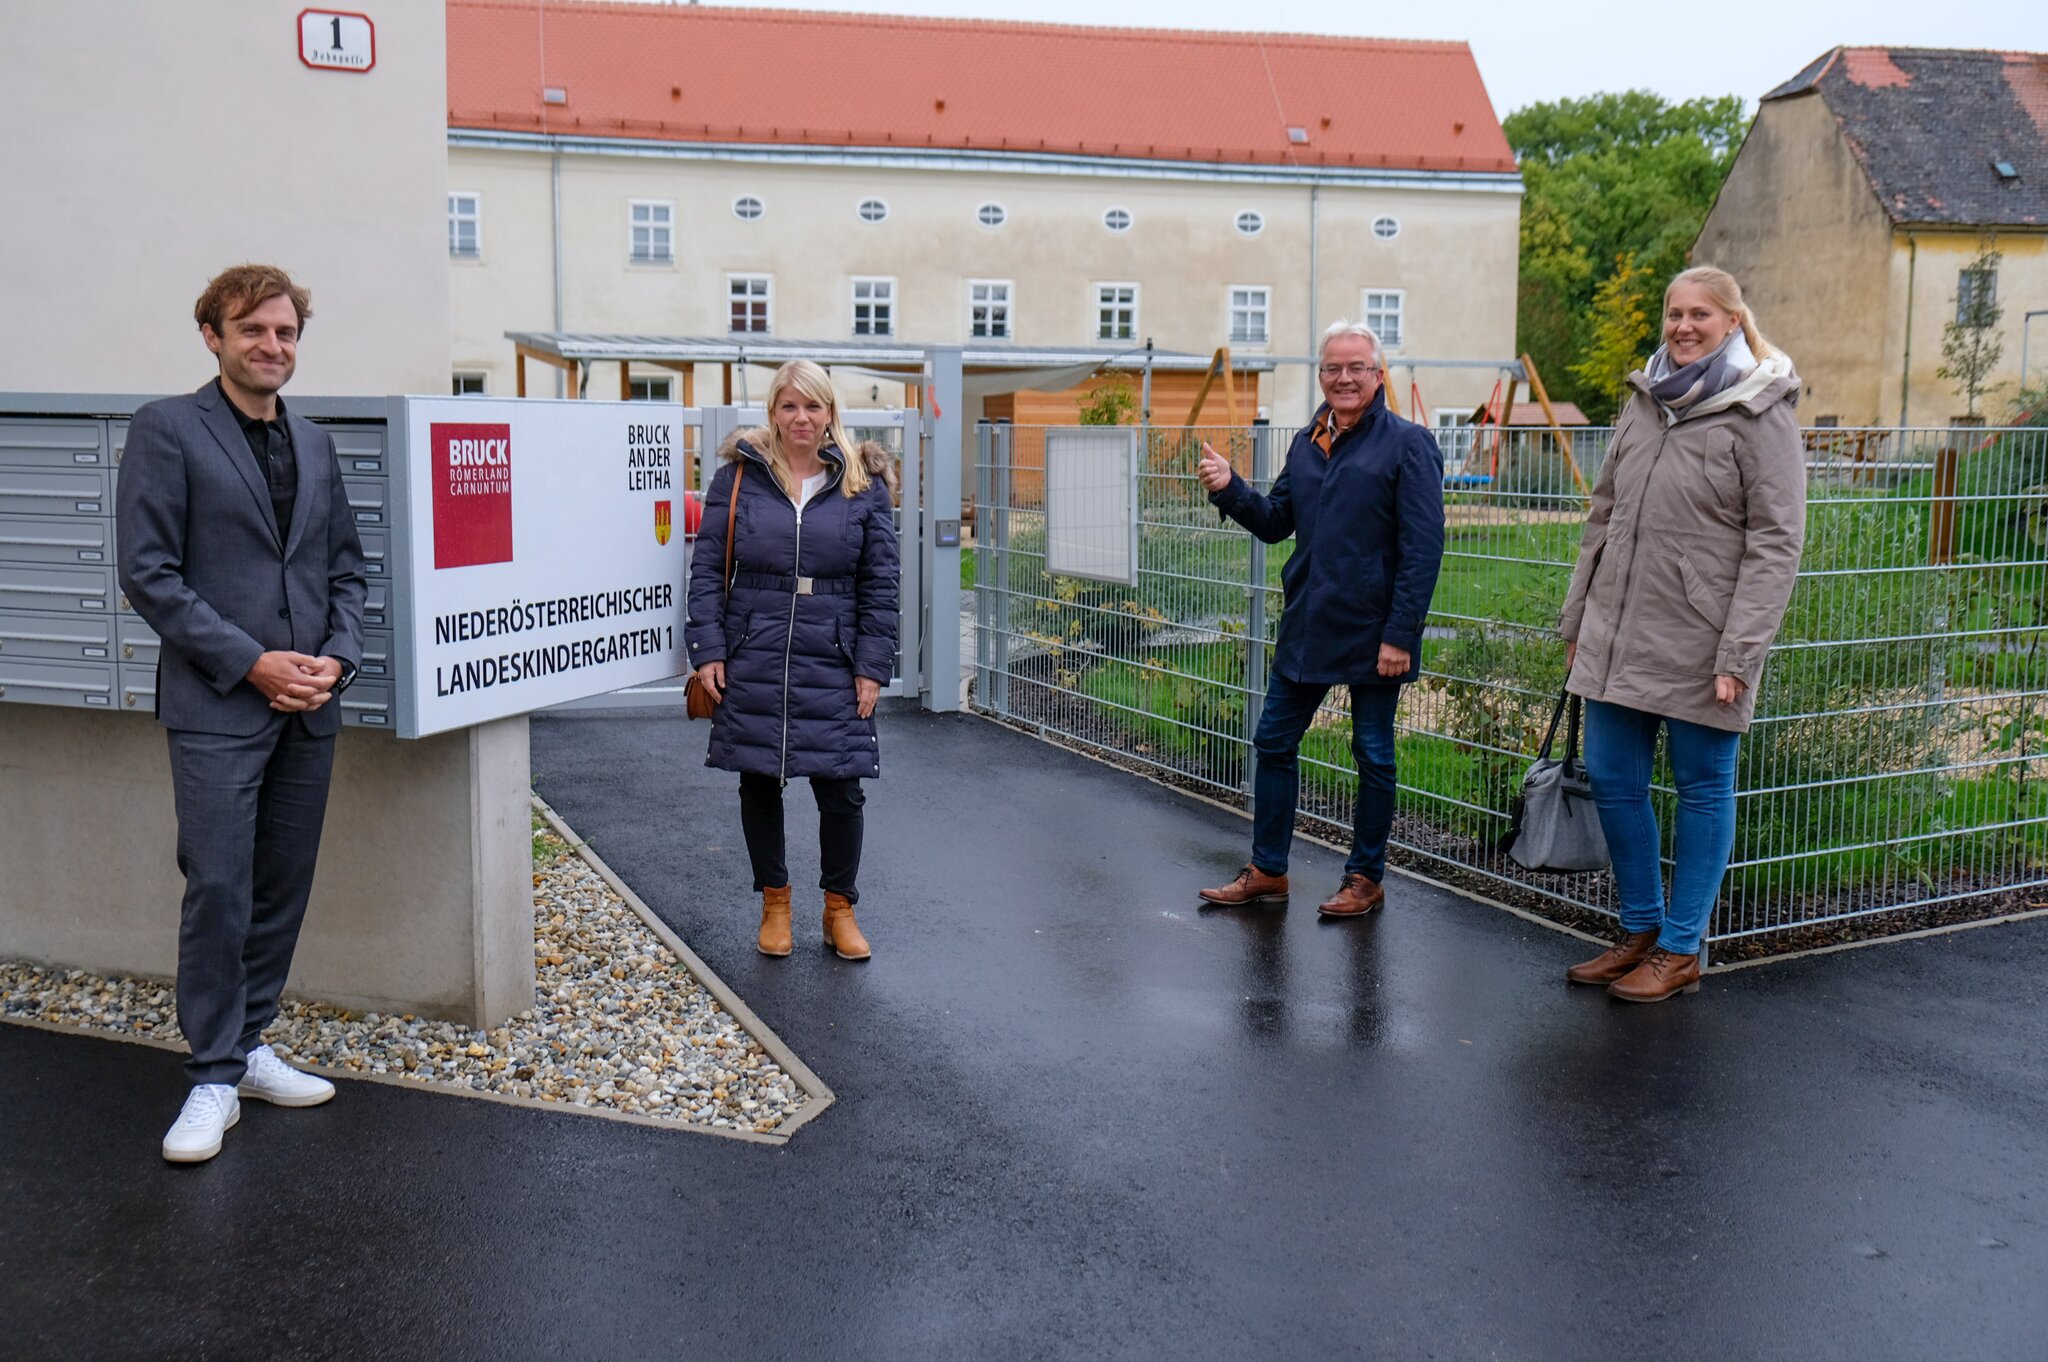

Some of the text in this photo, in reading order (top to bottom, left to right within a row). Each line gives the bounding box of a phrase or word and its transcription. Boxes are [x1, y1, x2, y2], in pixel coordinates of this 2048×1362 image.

[329, 15, 344, 51] 1
[628, 424, 670, 445] BRUCK
[449, 438, 508, 466] BRUCK
[628, 447, 671, 468] AN DER
[450, 466, 509, 482] RÖMERLAND
[629, 469, 671, 491] LEITHA
[450, 481, 510, 496] CARNUNTUM
[435, 583, 673, 645] NIEDERÖSTERREICHISCHER
[436, 625, 673, 697] LANDESKINDERGARTEN 1
